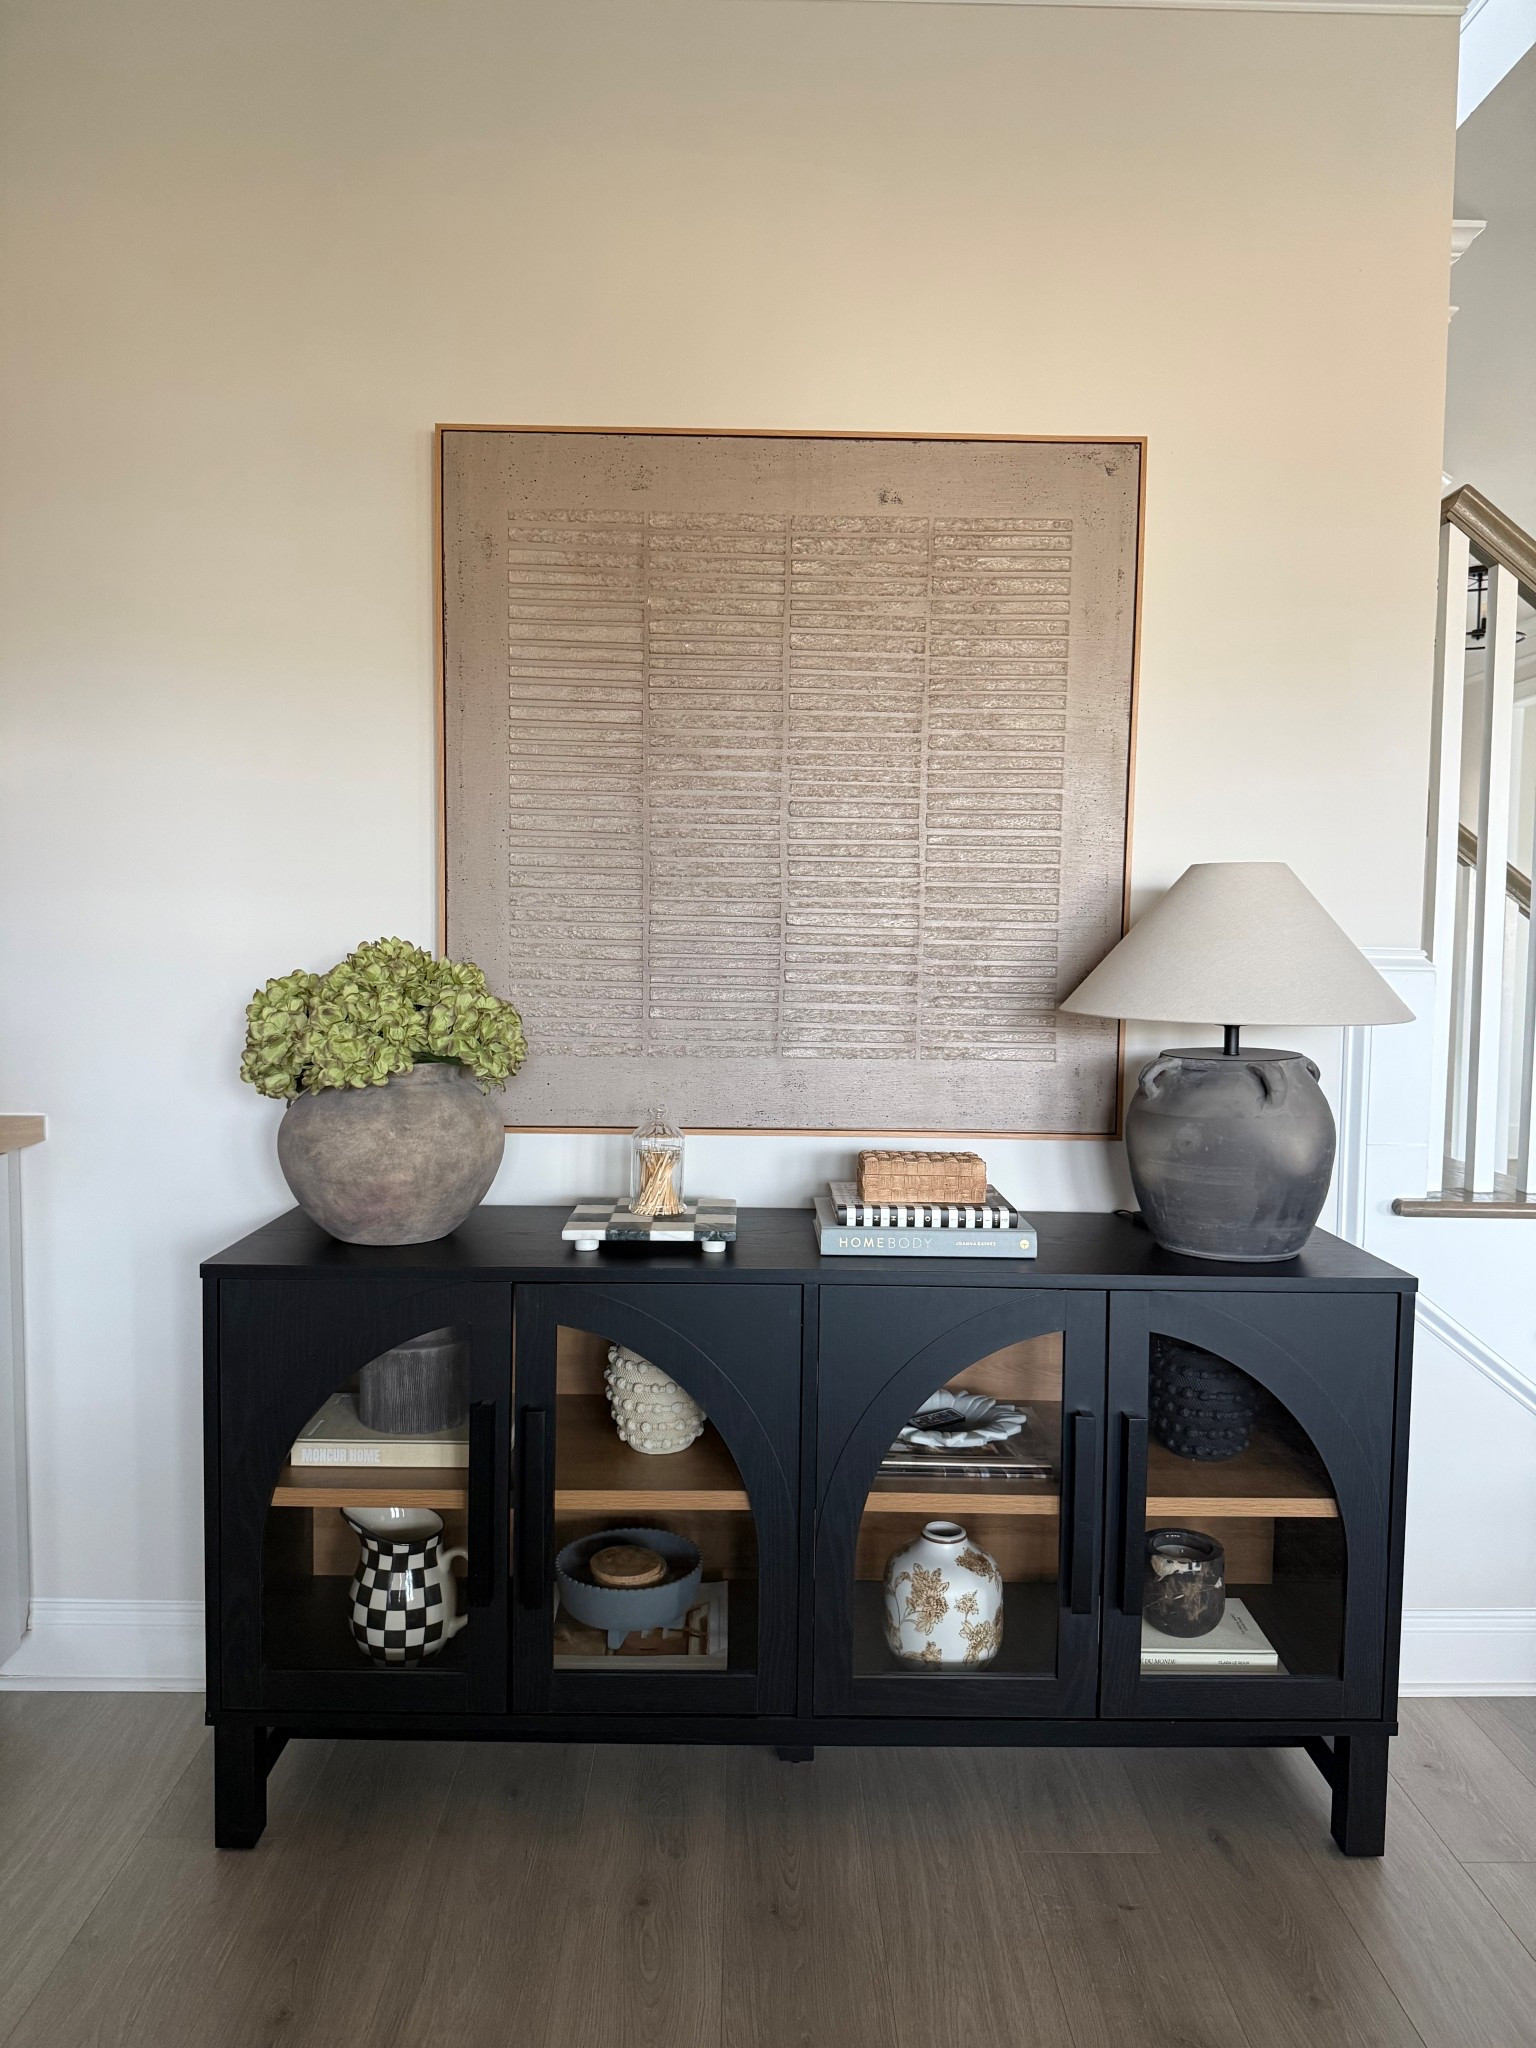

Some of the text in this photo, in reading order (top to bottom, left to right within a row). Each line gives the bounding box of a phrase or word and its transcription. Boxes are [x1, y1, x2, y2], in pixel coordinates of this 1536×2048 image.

[839, 1237, 933, 1249] HOMEBODY
[301, 1448, 381, 1462] MONCUR HOME
